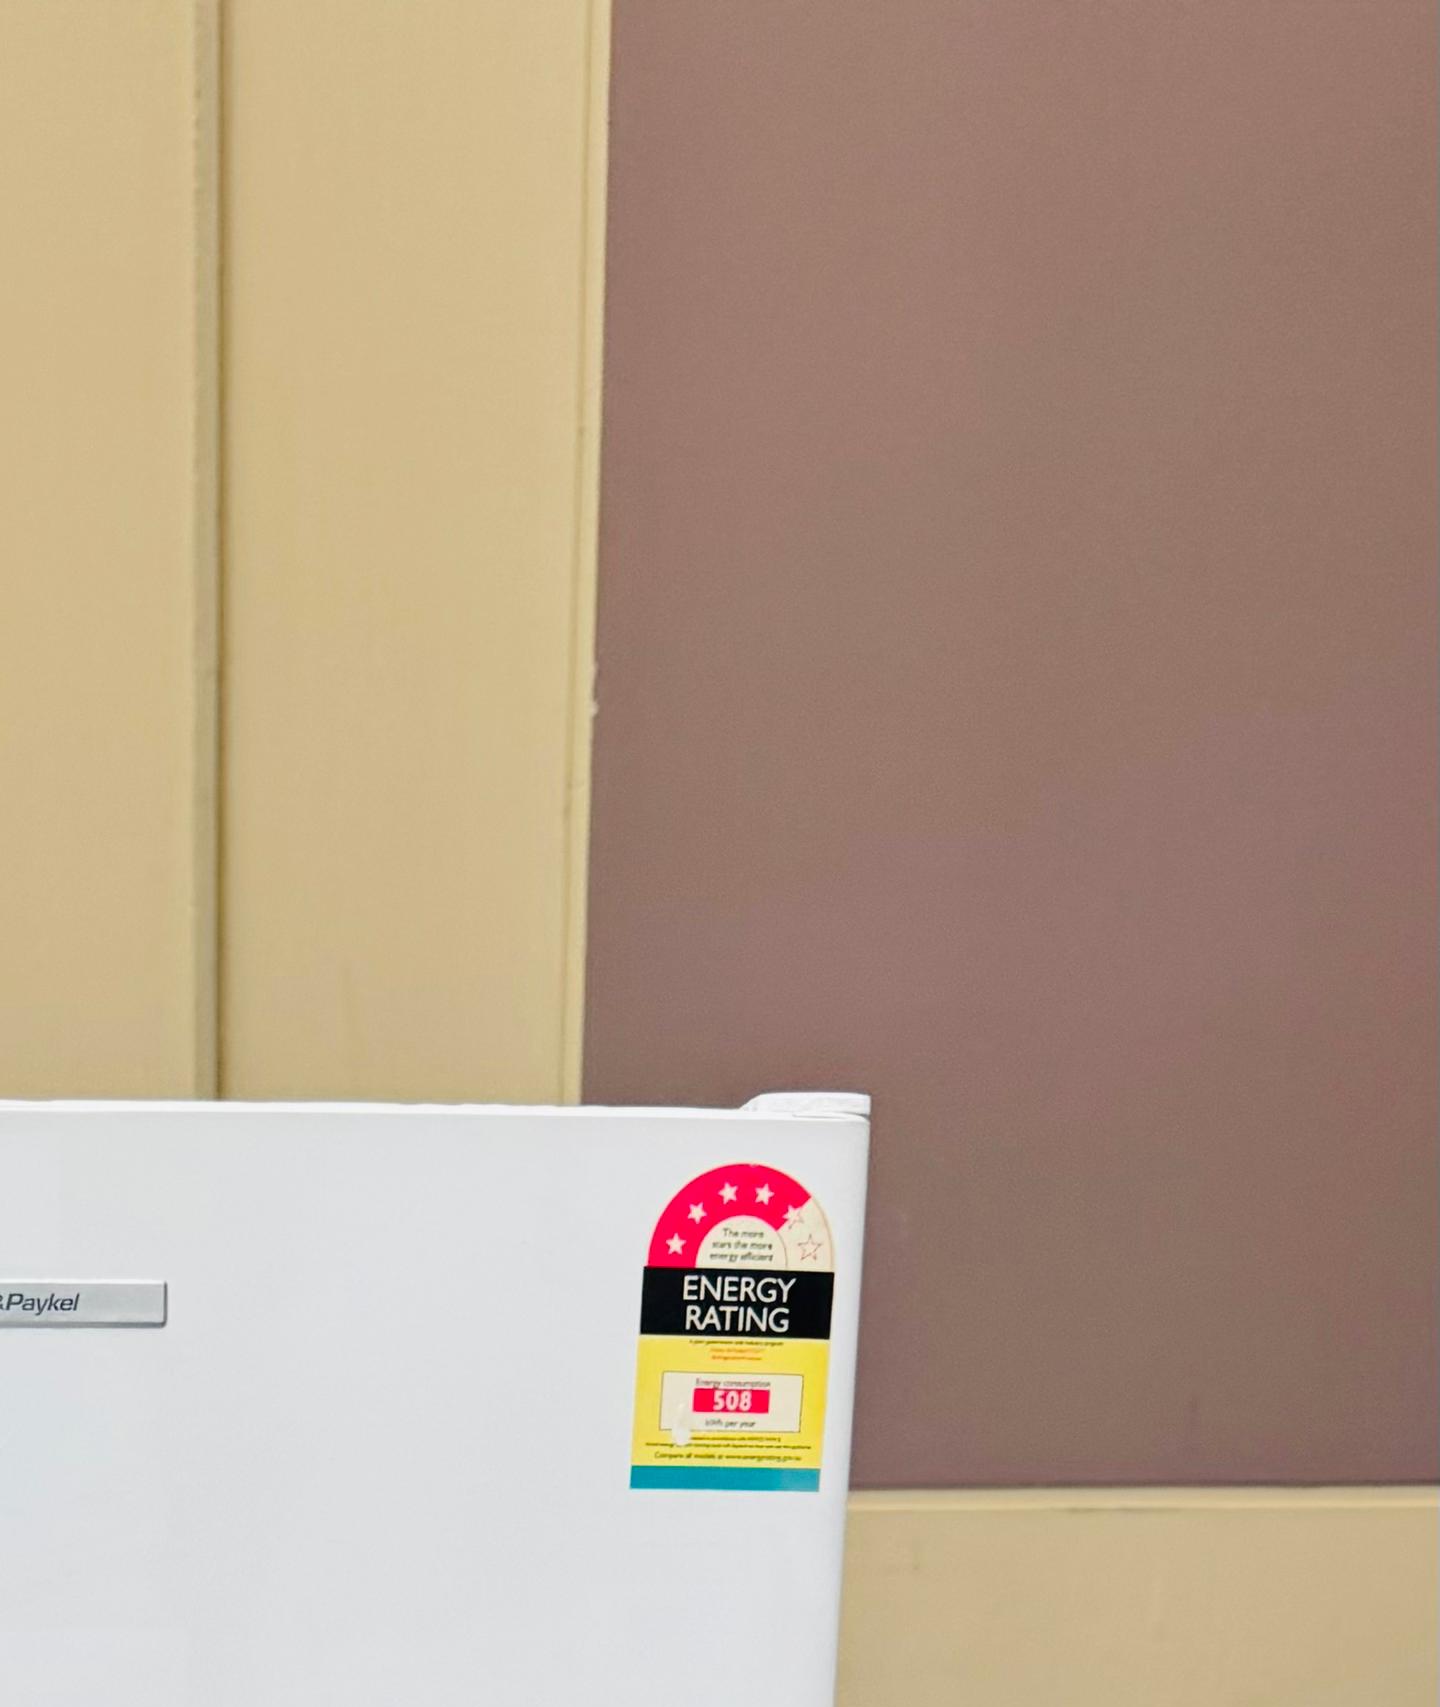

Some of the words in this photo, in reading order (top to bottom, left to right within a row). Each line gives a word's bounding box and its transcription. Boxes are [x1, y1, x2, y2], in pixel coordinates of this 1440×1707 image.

[682, 1275, 797, 1303] ENERGY
[685, 1305, 790, 1333] RATING
[696, 1378, 720, 1388] Energy
[722, 1380, 771, 1389] consumption
[713, 1390, 752, 1411] 508
